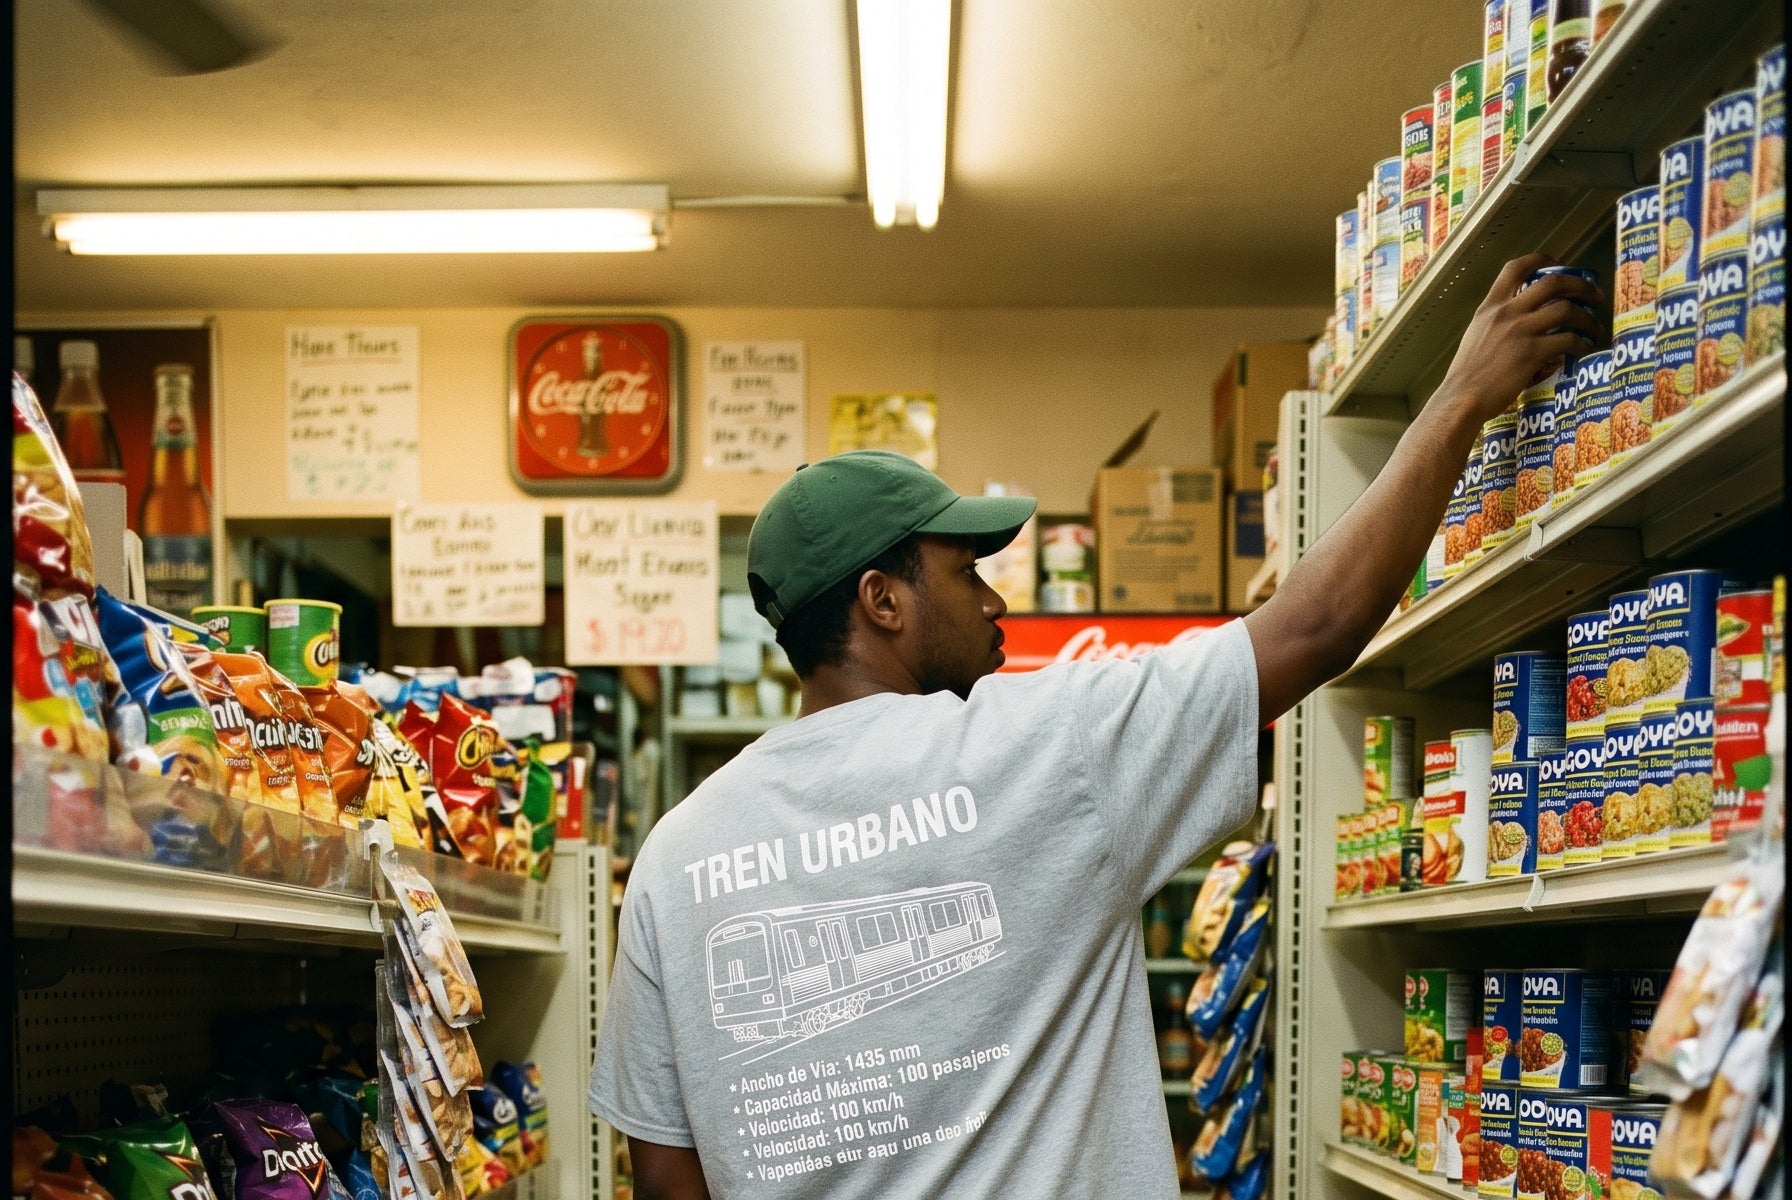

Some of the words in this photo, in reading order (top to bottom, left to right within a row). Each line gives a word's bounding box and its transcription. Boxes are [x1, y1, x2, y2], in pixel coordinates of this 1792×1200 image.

[1706, 101, 1754, 140] OYA
[1700, 264, 1743, 302] OYA
[1655, 299, 1698, 333] OYA
[1518, 411, 1555, 441] OYA
[1566, 747, 1605, 771] GOY
[1491, 772, 1523, 797] OYA
[684, 838, 787, 904] TREN
[799, 786, 978, 874] URBANO
[1484, 977, 1500, 995] YA
[1523, 977, 1557, 995] OYA
[741, 1073, 784, 1094] Ancho
[788, 1065, 808, 1083] de
[845, 1047, 886, 1072] 1435
[889, 1044, 921, 1062] mm
[744, 1084, 822, 1116] Capacidad
[825, 1074, 893, 1100] Máxima:
[897, 1062, 928, 1084] 100
[932, 1043, 1011, 1080] pasajeros
[749, 1107, 825, 1138] Velocidad:
[829, 1099, 859, 1121] 100
[863, 1091, 904, 1115] km/h
[1481, 1094, 1510, 1111] OYA
[1547, 1106, 1583, 1129] OYA
[753, 1133, 831, 1159] Velocidad:
[834, 1122, 865, 1143] 100
[868, 1113, 909, 1137] km/h
[903, 1131, 932, 1151] una
[1611, 1119, 1656, 1145] OYA
